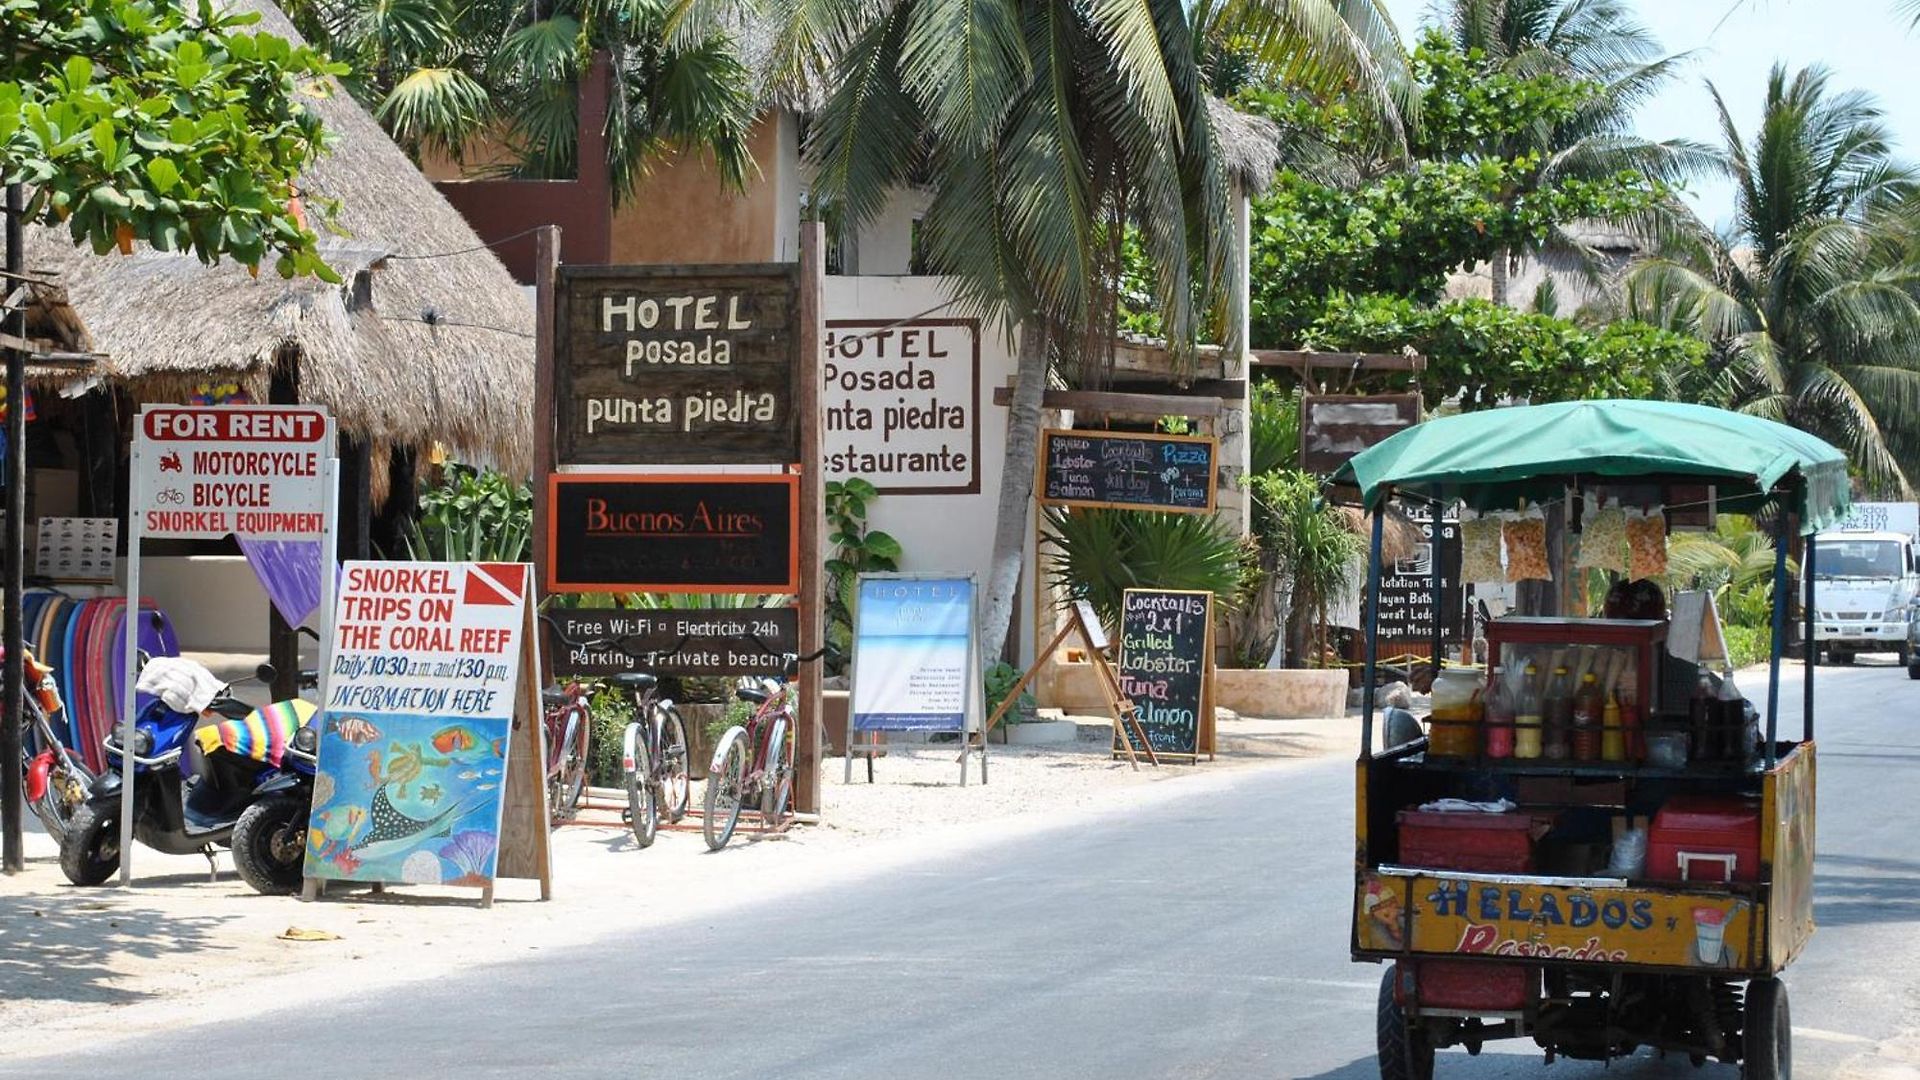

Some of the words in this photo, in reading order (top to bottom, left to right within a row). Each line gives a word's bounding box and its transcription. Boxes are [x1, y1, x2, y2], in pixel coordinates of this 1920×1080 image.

[603, 295, 751, 332] HOTEL
[625, 334, 731, 376] posada
[824, 360, 935, 391] Posada
[587, 397, 672, 433] punta
[684, 389, 775, 432] piedra
[827, 398, 873, 430] nta
[884, 397, 964, 442] piedra
[153, 413, 218, 437] FOR
[229, 414, 317, 438] RENT
[193, 451, 317, 477] MOTORCYCLE
[824, 444, 967, 473] staurante
[193, 483, 270, 507] BICYCLE
[146, 510, 229, 533] SNORKEL
[236, 511, 324, 534] EQUIPMENT
[586, 497, 685, 532] Buenos
[689, 500, 764, 533] Aires
[1421, 523, 1454, 539] Sa
[348, 568, 457, 595] SNORKEL
[1381, 577, 1419, 588] lotation
[343, 596, 412, 621] TRIPS
[418, 598, 454, 623] ON
[1377, 607, 1405, 620] weat
[339, 625, 382, 650] THE
[388, 626, 454, 652] CORAL
[459, 628, 512, 654] REEF
[567, 620, 602, 634] Free
[610, 619, 651, 635] Wi-Fi
[677, 620, 746, 638] Electricity
[751, 620, 779, 636] 24h
[1124, 633, 1174, 650] Grilled
[570, 650, 634, 668] Parking
[1122, 649, 1196, 674] Lobster
[330, 685, 448, 712] INFORMATION
[447, 689, 497, 714] HERE
[1120, 675, 1169, 701] Tuna
[1427, 880, 1654, 930] HELADOS
